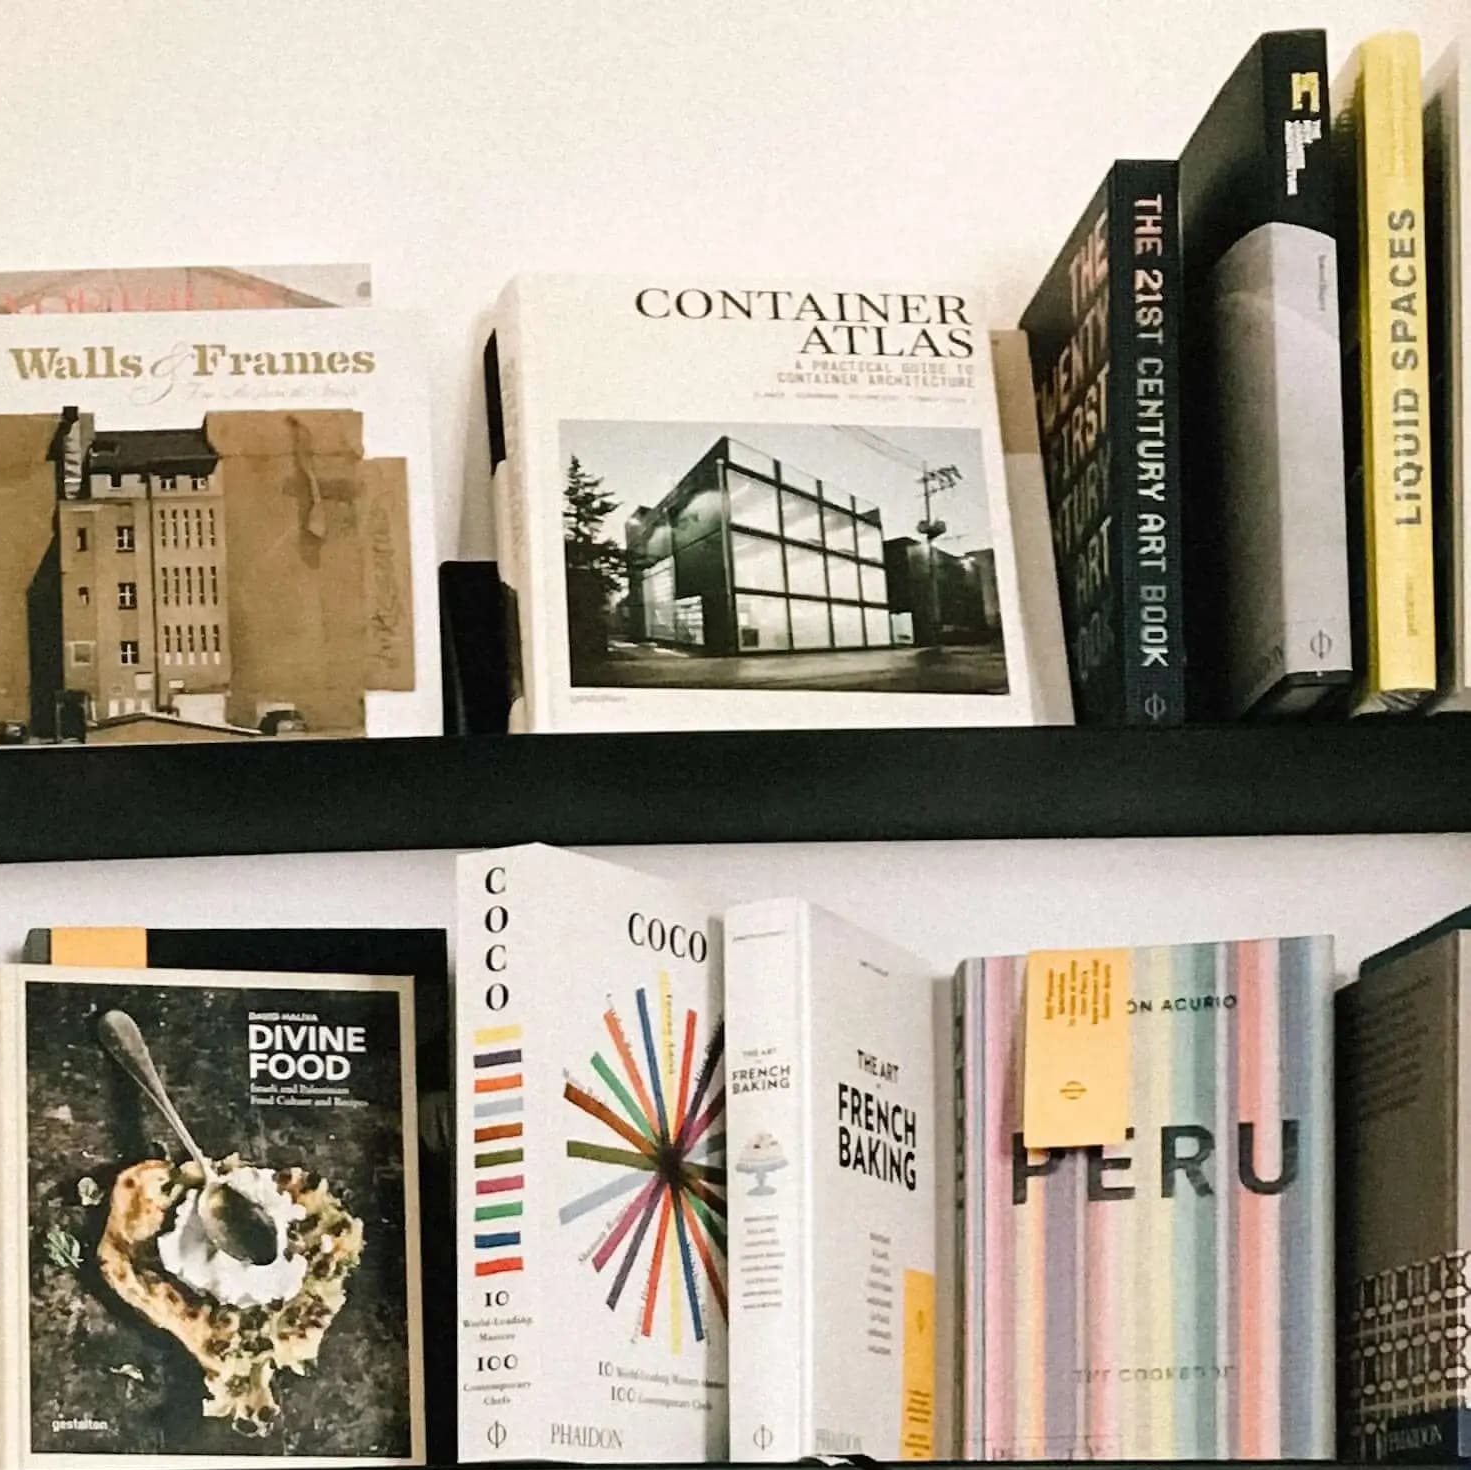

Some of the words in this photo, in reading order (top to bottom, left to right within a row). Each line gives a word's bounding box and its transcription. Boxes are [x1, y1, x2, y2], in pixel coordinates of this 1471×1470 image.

[1134, 194, 1163, 256] THE
[1069, 212, 1108, 315] THE
[635, 287, 973, 326] CONTAINER
[1134, 269, 1164, 345] 21ST
[1388, 208, 1418, 371] SPACES
[800, 325, 975, 359] ATLAS
[9, 345, 144, 381] Walls
[191, 344, 377, 377] Frames
[776, 372, 859, 385] CONTAINER
[867, 373, 976, 388] ARCHITECTURE
[1136, 357, 1166, 502] CENTURY
[1394, 388, 1423, 526] LIQUID
[1137, 513, 1167, 572] ART
[1139, 584, 1169, 667] BOOK
[628, 911, 708, 964] COCO
[1160, 994, 1238, 1012] ACURIO
[248, 1023, 367, 1053] DIVINE
[249, 1052, 351, 1081] FOOD
[731, 1065, 791, 1082] FRENCH
[856, 1048, 878, 1076] THE
[880, 1064, 899, 1084] ART
[731, 1078, 791, 1095] BAKING
[837, 1082, 917, 1149] FRENCH
[838, 1125, 917, 1192] BAKING
[1010, 1118, 1300, 1206] PERU
[484, 1290, 510, 1308] 10
[477, 1353, 519, 1372] 100
[598, 1360, 614, 1378] 10
[611, 1385, 637, 1402] 100
[51, 1416, 109, 1432] gestalten
[551, 1422, 624, 1449] PHAIDON
